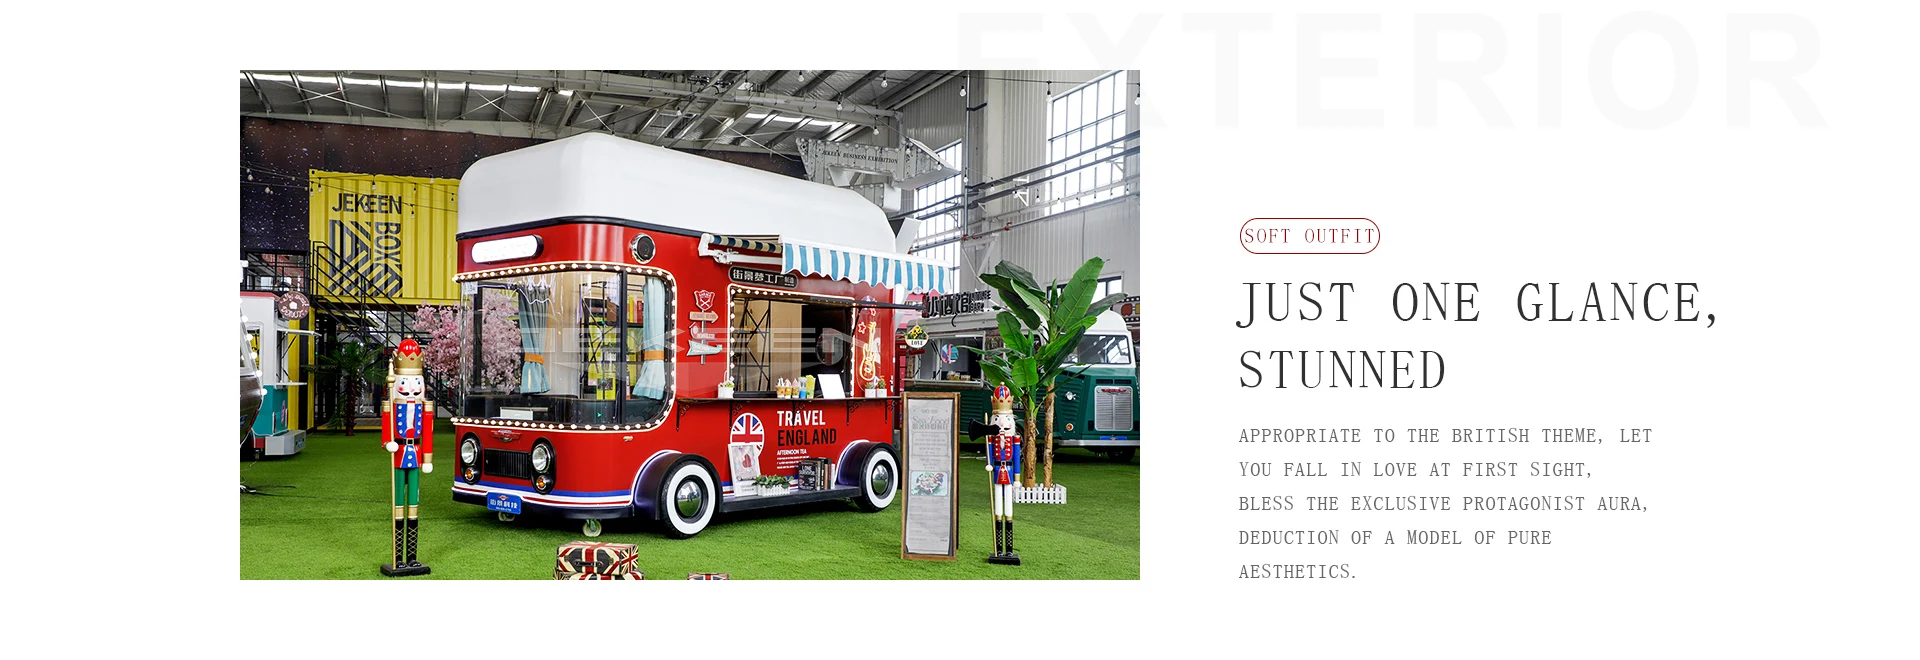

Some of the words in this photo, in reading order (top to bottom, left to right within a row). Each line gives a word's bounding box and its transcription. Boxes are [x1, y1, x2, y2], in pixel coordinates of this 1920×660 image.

[332, 192, 402, 215] JEKEEN
[374, 221, 401, 263] BOX
[777, 410, 826, 426] TRAVEL
[778, 428, 837, 447] ENGLAND
